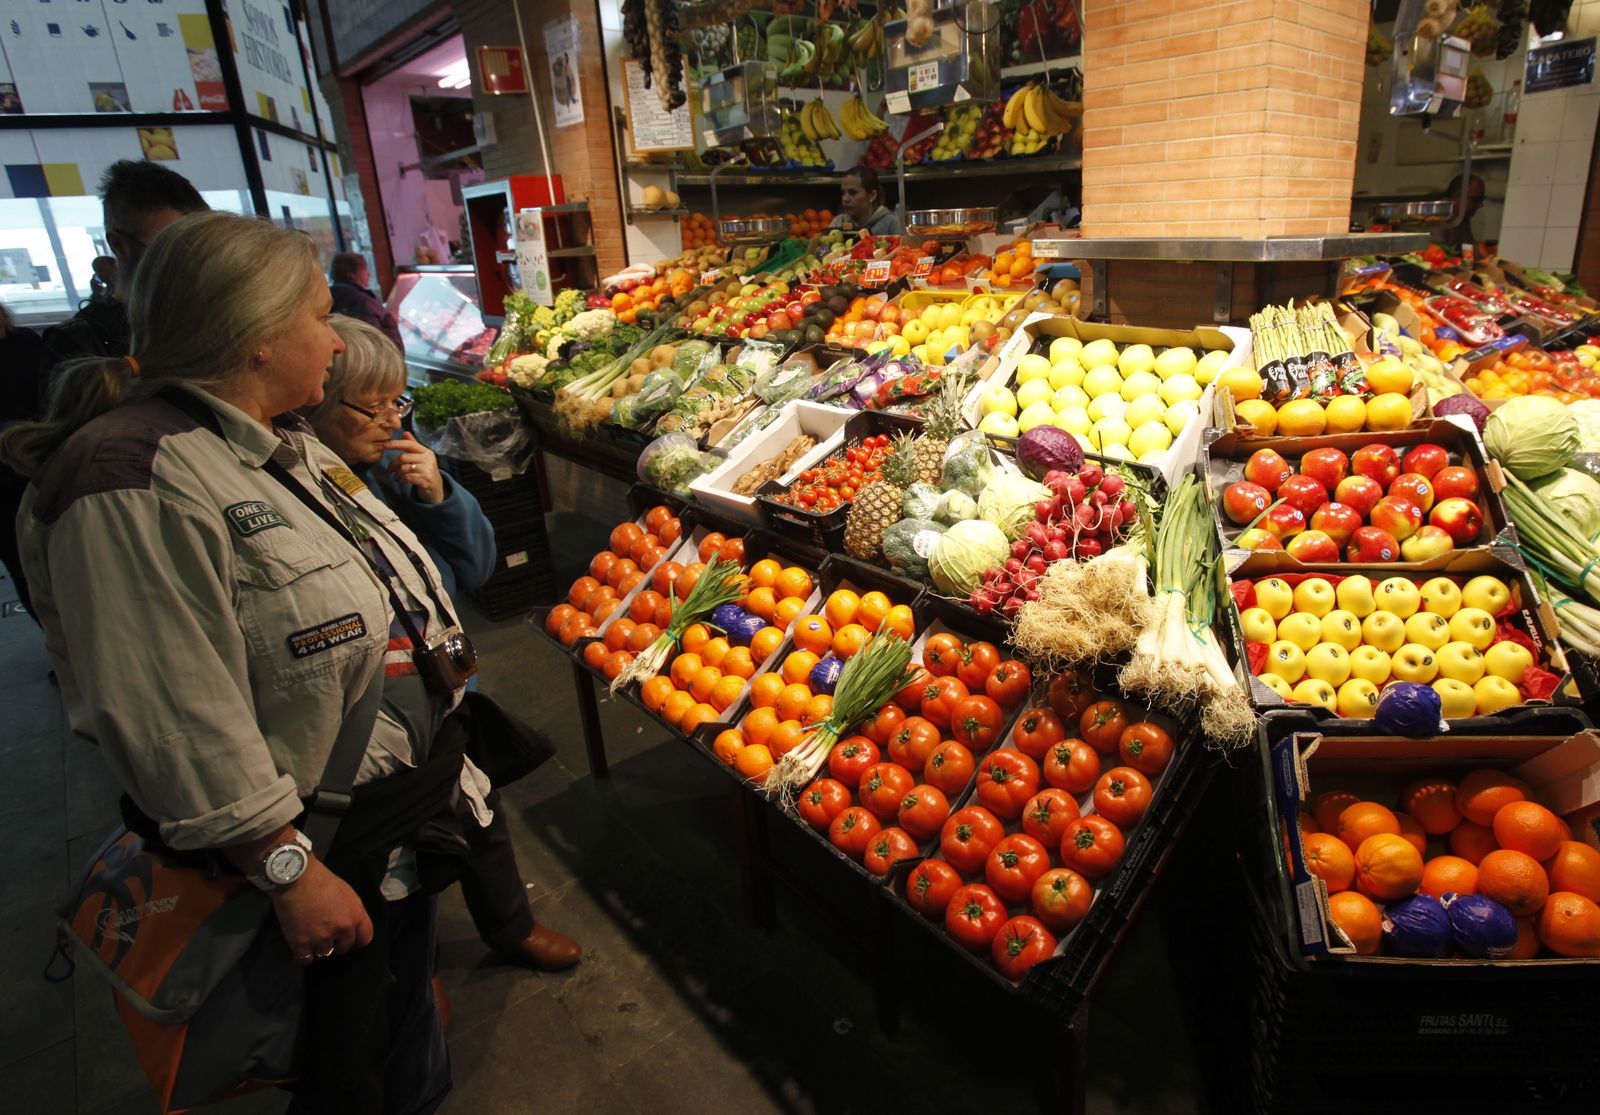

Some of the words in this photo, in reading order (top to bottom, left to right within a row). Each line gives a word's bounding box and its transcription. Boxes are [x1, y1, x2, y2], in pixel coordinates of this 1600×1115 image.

[1530, 46, 1591, 65] ZAPATERO
[235, 504, 261, 518] ONE
[247, 514, 277, 529] LIVE
[320, 622, 340, 633] CAMEL
[339, 615, 360, 626] TROPHY
[294, 621, 363, 649] PROFESSIONAL
[328, 627, 363, 644] WEAR
[1420, 1015, 1457, 1027] FRUTAS
